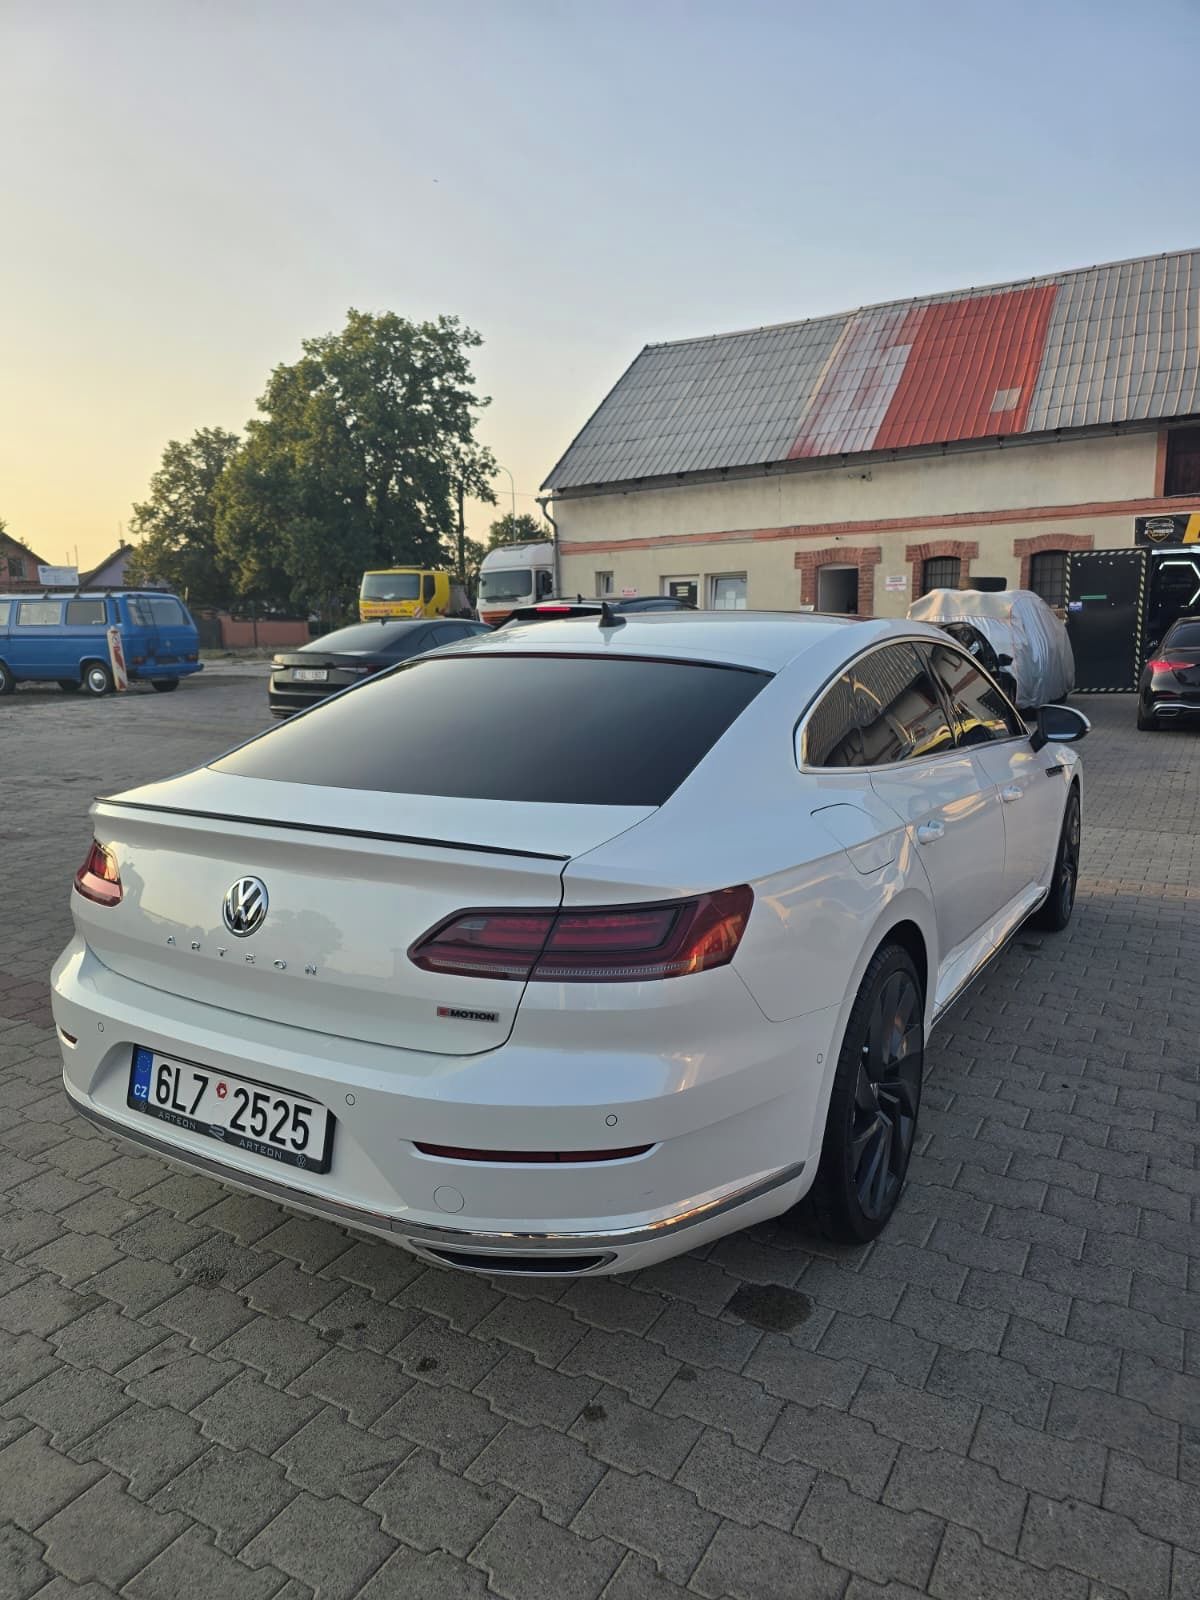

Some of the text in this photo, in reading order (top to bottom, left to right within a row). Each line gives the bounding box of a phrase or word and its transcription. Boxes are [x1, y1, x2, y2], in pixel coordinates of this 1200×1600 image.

[167, 935, 317, 975] ARTEON
[437, 1007, 496, 1021] MOTION
[134, 1084, 147, 1098] CZ
[155, 1063, 313, 1151] 6L7 2525
[158, 1111, 197, 1129] ARTEON
[239, 1139, 282, 1160] ARTEON
